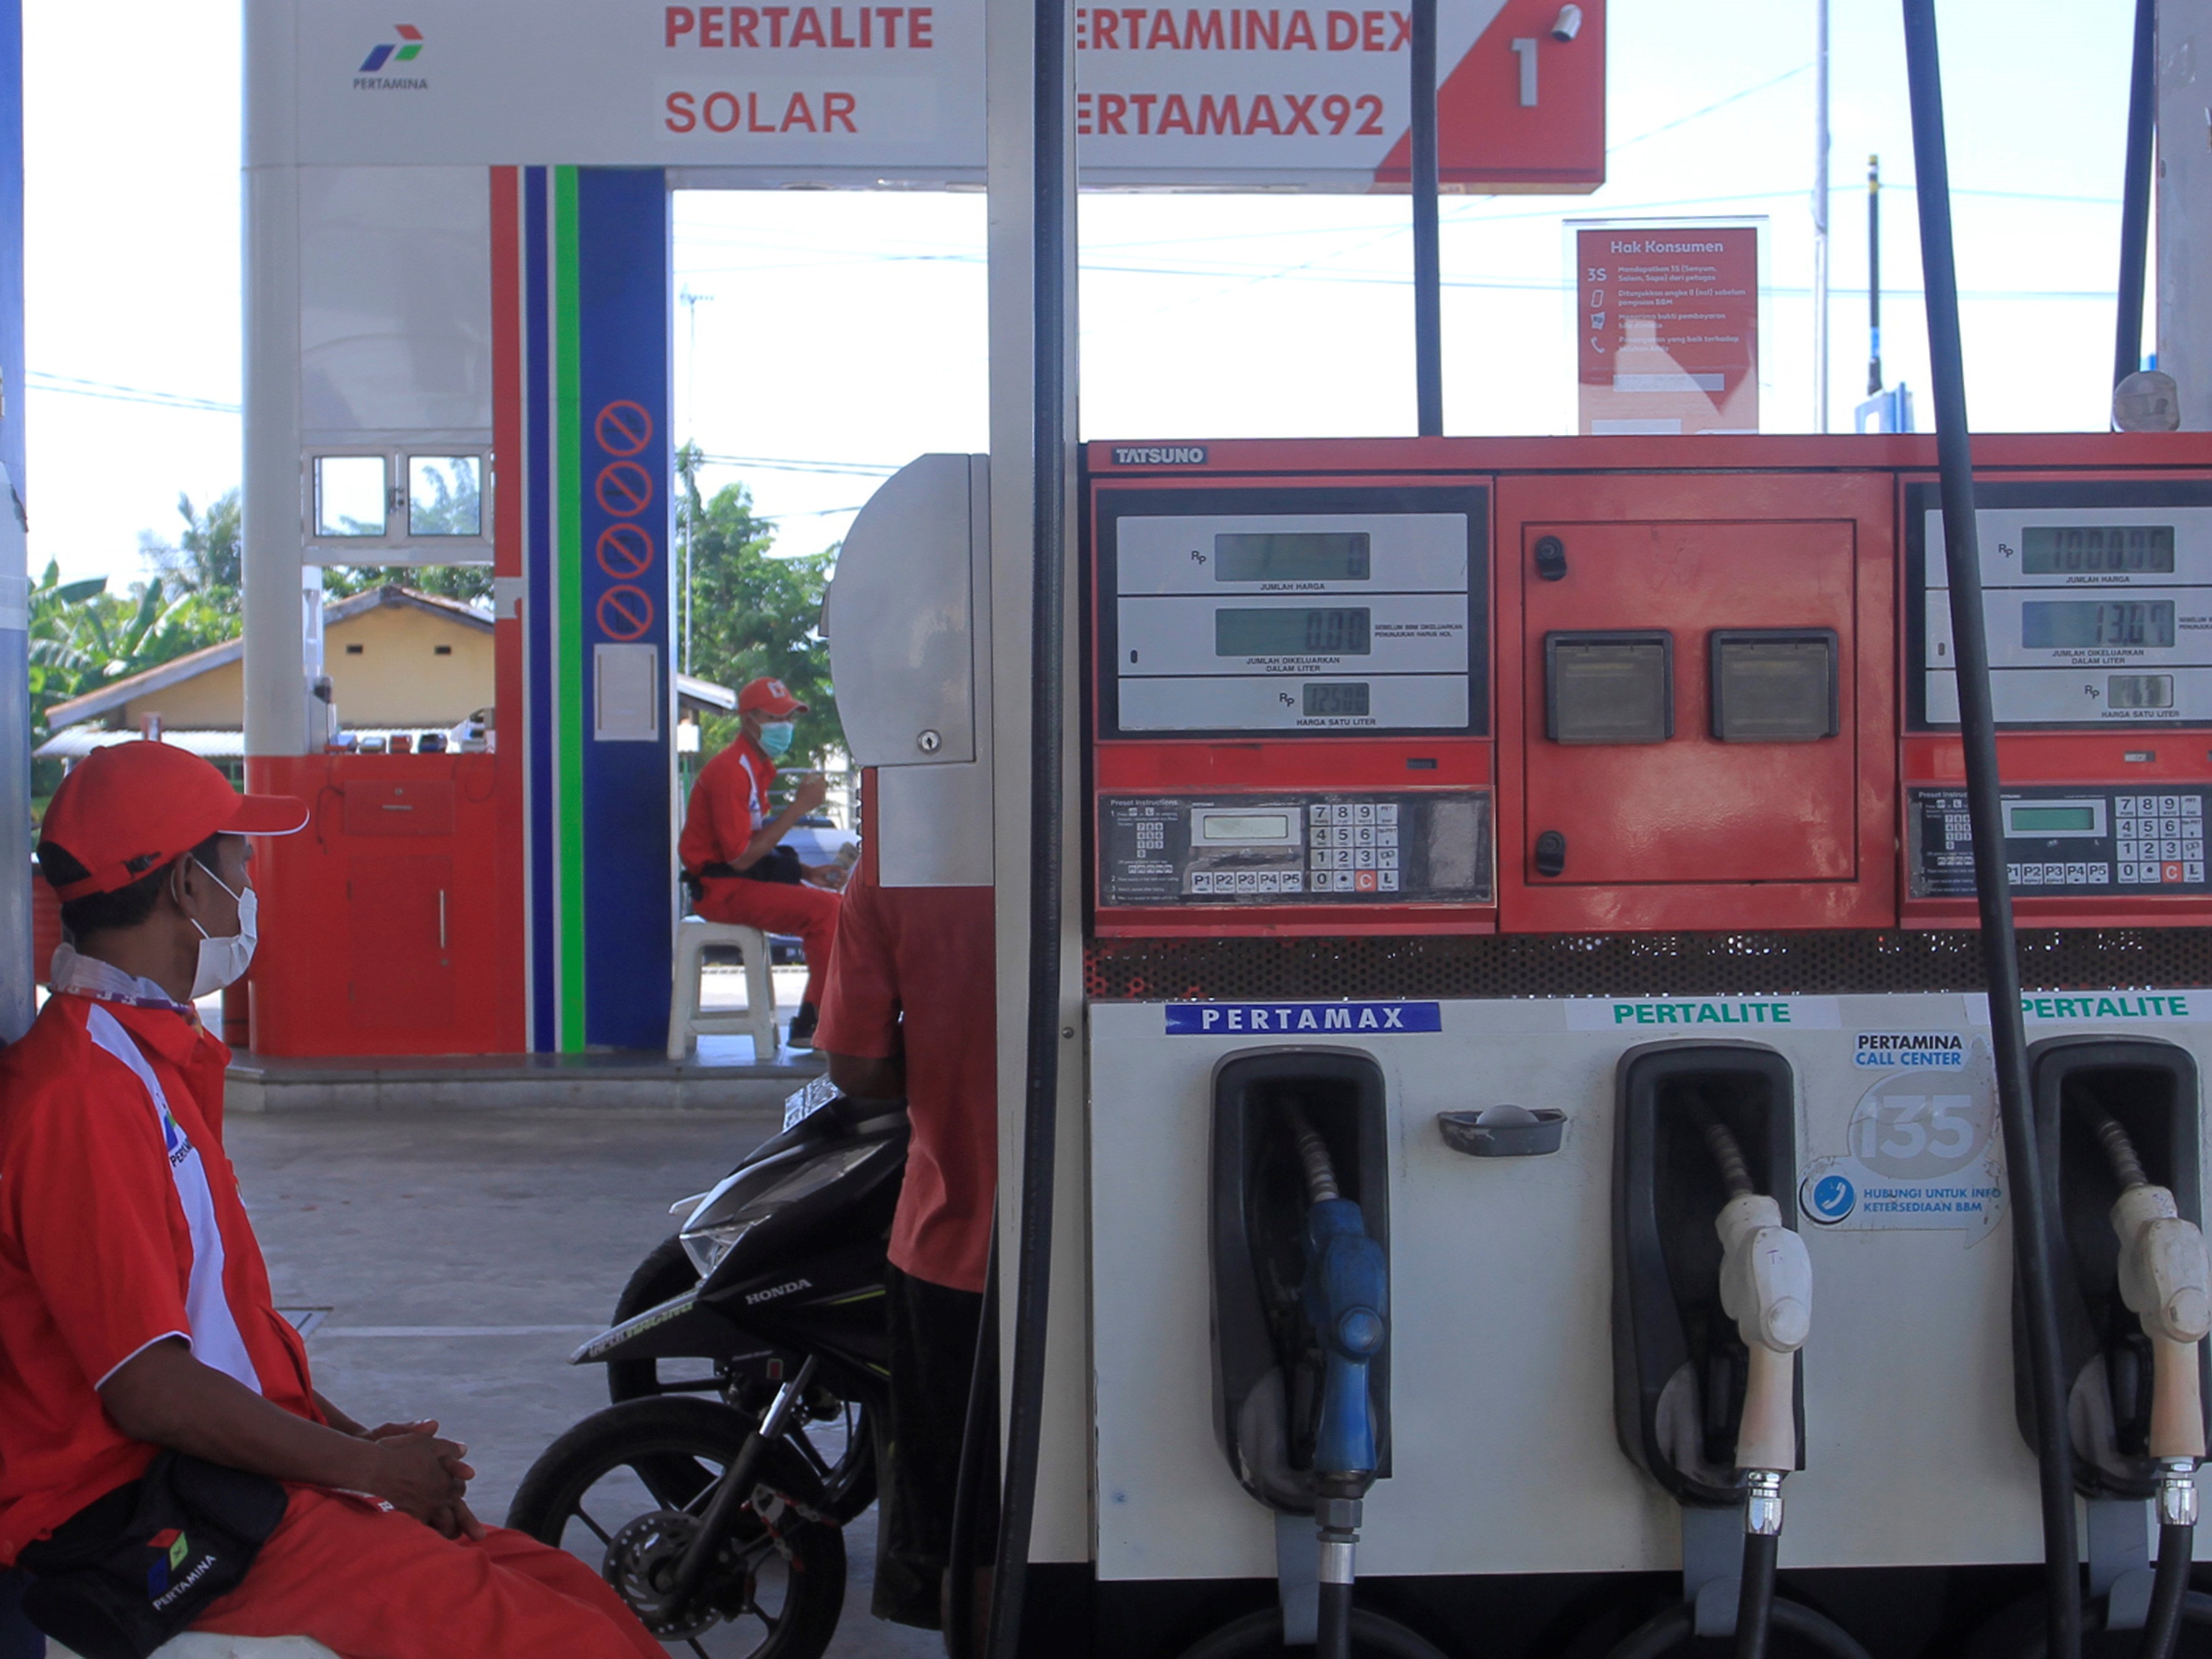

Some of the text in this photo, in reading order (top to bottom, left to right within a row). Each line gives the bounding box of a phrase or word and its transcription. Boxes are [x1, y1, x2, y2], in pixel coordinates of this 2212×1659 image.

[664, 6, 933, 49] PERTALITE
[1077, 9, 1411, 52] RTAMINA DEX
[1511, 38, 1538, 106] 1
[353, 78, 429, 90] PERTAMINA
[664, 91, 858, 133] SOLAR
[1077, 93, 1384, 136] ERTAMAX92
[1610, 240, 1724, 253] Hak Konsumen
[1587, 267, 1607, 281] 3S
[1116, 447, 1204, 463] TATSUNO
[2121, 799, 2131, 809] 7
[2143, 798, 2152, 809] 8
[2165, 798, 2174, 809] 9
[1316, 807, 1326, 818] 7
[1338, 806, 1348, 818] 8
[1360, 806, 1370, 818] 9
[2122, 821, 2131, 832] 4
[2144, 820, 2153, 832] 5
[2165, 820, 2175, 832] 6
[1316, 829, 1326, 840] 4
[1339, 829, 1348, 840] 5
[1360, 829, 1370, 840] 6
[2123, 842, 2176, 854] 1 2 3
[1317, 850, 1370, 863] 1 2 3
[2024, 867, 2041, 876] P2
[2046, 866, 2063, 876] P3
[2068, 866, 2084, 875] P4
[2089, 865, 2106, 875] P5
[2124, 864, 2198, 880] 0 C L
[1194, 874, 1300, 885] P1 P2 P3 P4 P5
[1317, 873, 1392, 888] 0 C L
[1613, 1003, 1791, 1024] PERTALITE
[2020, 997, 2189, 1018] PERTALITE
[1202, 1008, 1404, 1029] PERTAMAX
[1858, 1035, 1963, 1049] PERTAMINA
[1856, 1052, 1961, 1065] CALL CENTER
[1861, 1094, 1974, 1159] 135
[1864, 1187, 2002, 1199] HUBUNGI UNTUK INFO
[1864, 1202, 1982, 1212] KETERSEDIAAN BBM
[745, 1278, 812, 1304] HONDA
[152, 1554, 216, 1610] PERTAMINA
